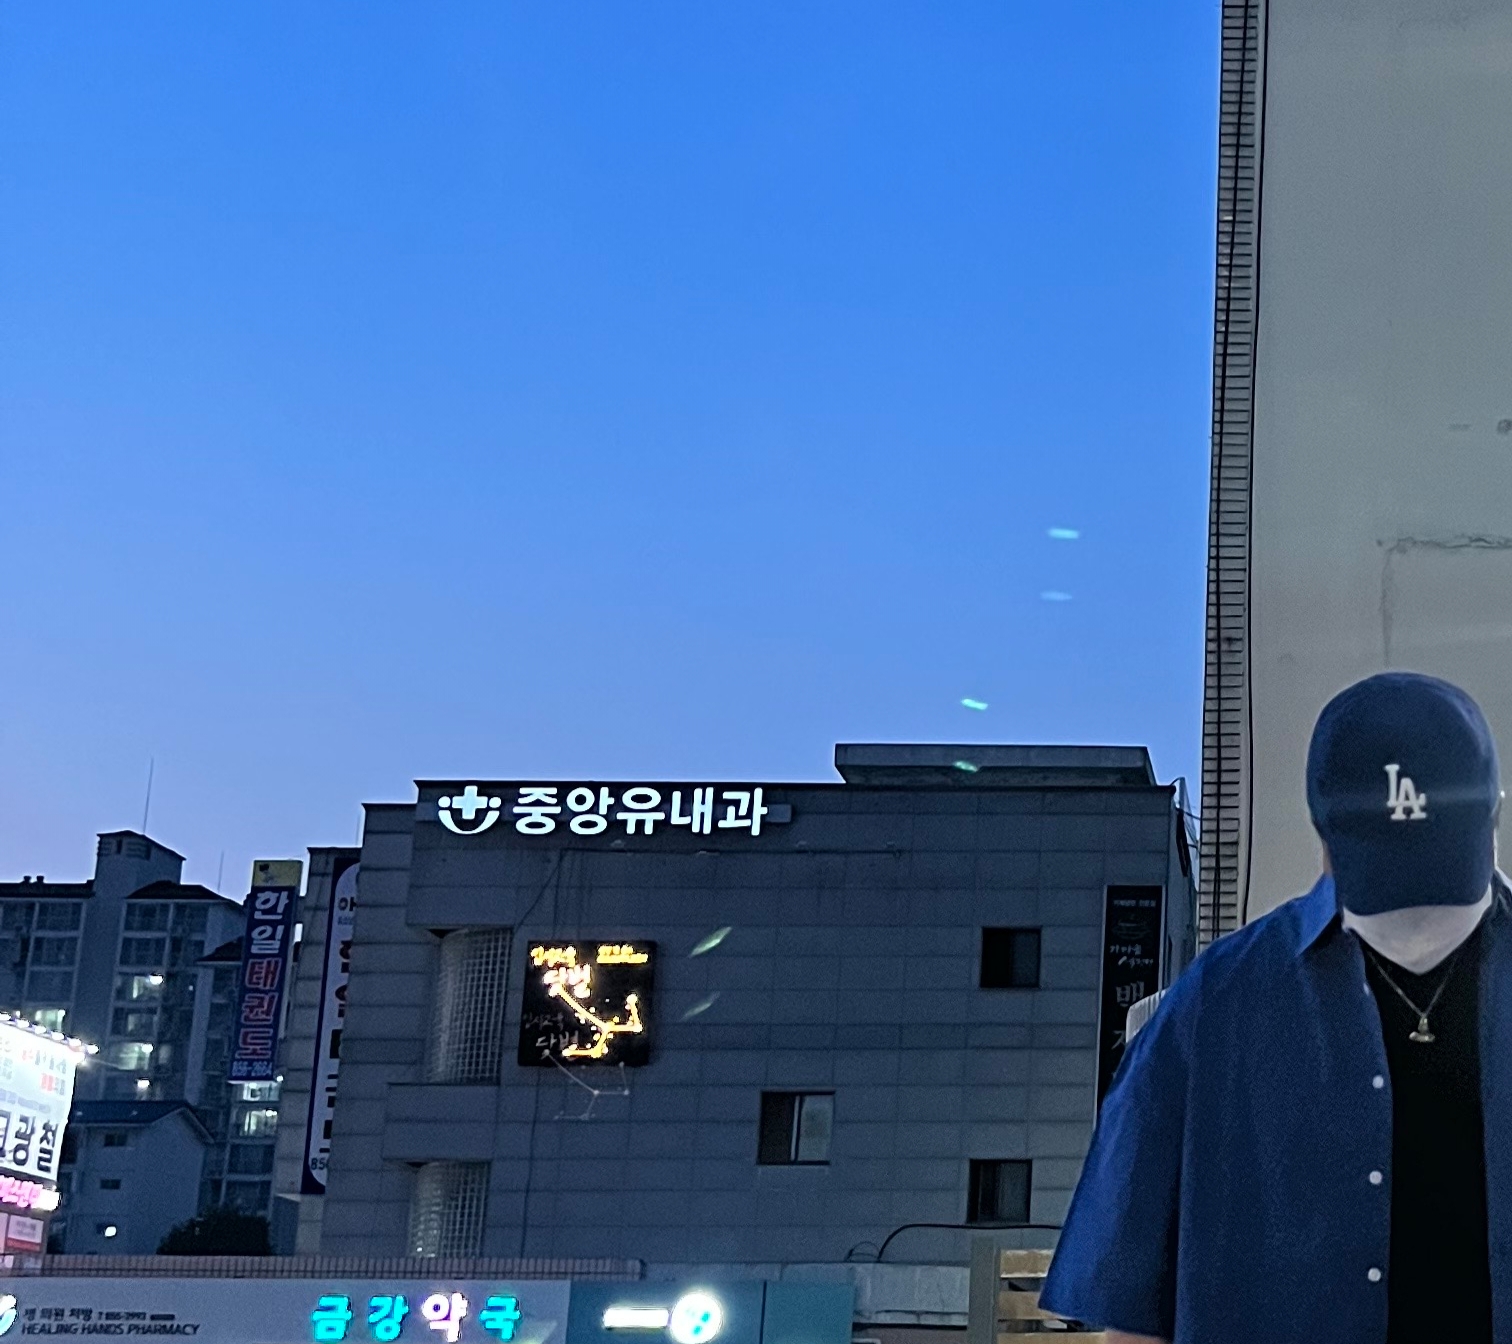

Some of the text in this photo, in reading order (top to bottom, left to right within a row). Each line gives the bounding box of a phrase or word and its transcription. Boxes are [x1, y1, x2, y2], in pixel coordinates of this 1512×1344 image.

[512, 786, 768, 837] 중앙유내과
[1383, 763, 1427, 822] LA
[237, 889, 289, 1060] 한일태권도
[21, 1322, 200, 1336] HEALING HANDS PHARMACY
[311, 1291, 523, 1343] 금강약국
